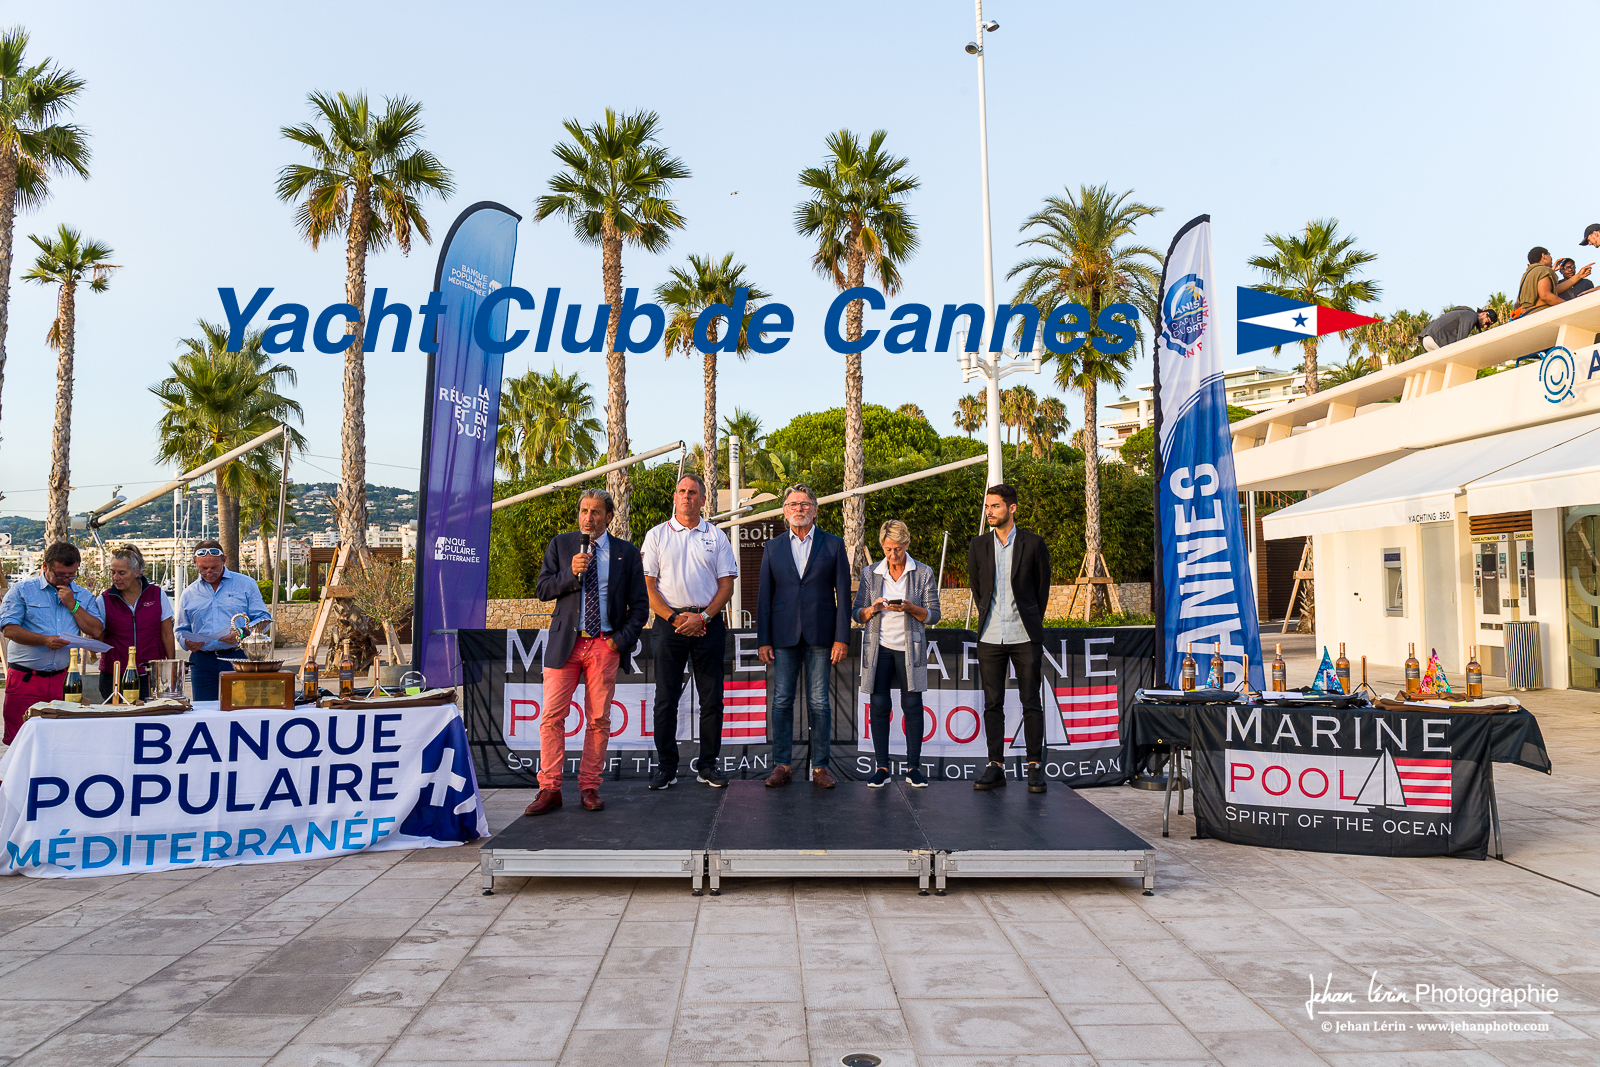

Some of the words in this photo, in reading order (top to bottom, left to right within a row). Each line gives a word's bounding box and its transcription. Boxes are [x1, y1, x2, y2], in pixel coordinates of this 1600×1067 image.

[461, 264, 488, 282] BANQUE
[477, 384, 490, 401] LA
[474, 411, 488, 428] EN
[1408, 513, 1437, 523] YACHTING
[444, 545, 477, 556] PULAIRE
[445, 537, 467, 547] NQUE
[133, 713, 403, 765] BANQUE
[1225, 706, 1452, 754] MARINE
[945, 763, 977, 780] OF
[1044, 756, 1122, 779] OCEAN
[26, 760, 400, 822] POPULAIRE
[1229, 762, 1358, 801] POOL
[1225, 805, 1291, 828] SPIRIT
[1298, 813, 1323, 830] OF
[1332, 816, 1374, 833] THE
[1382, 818, 1453, 837] OCEAN
